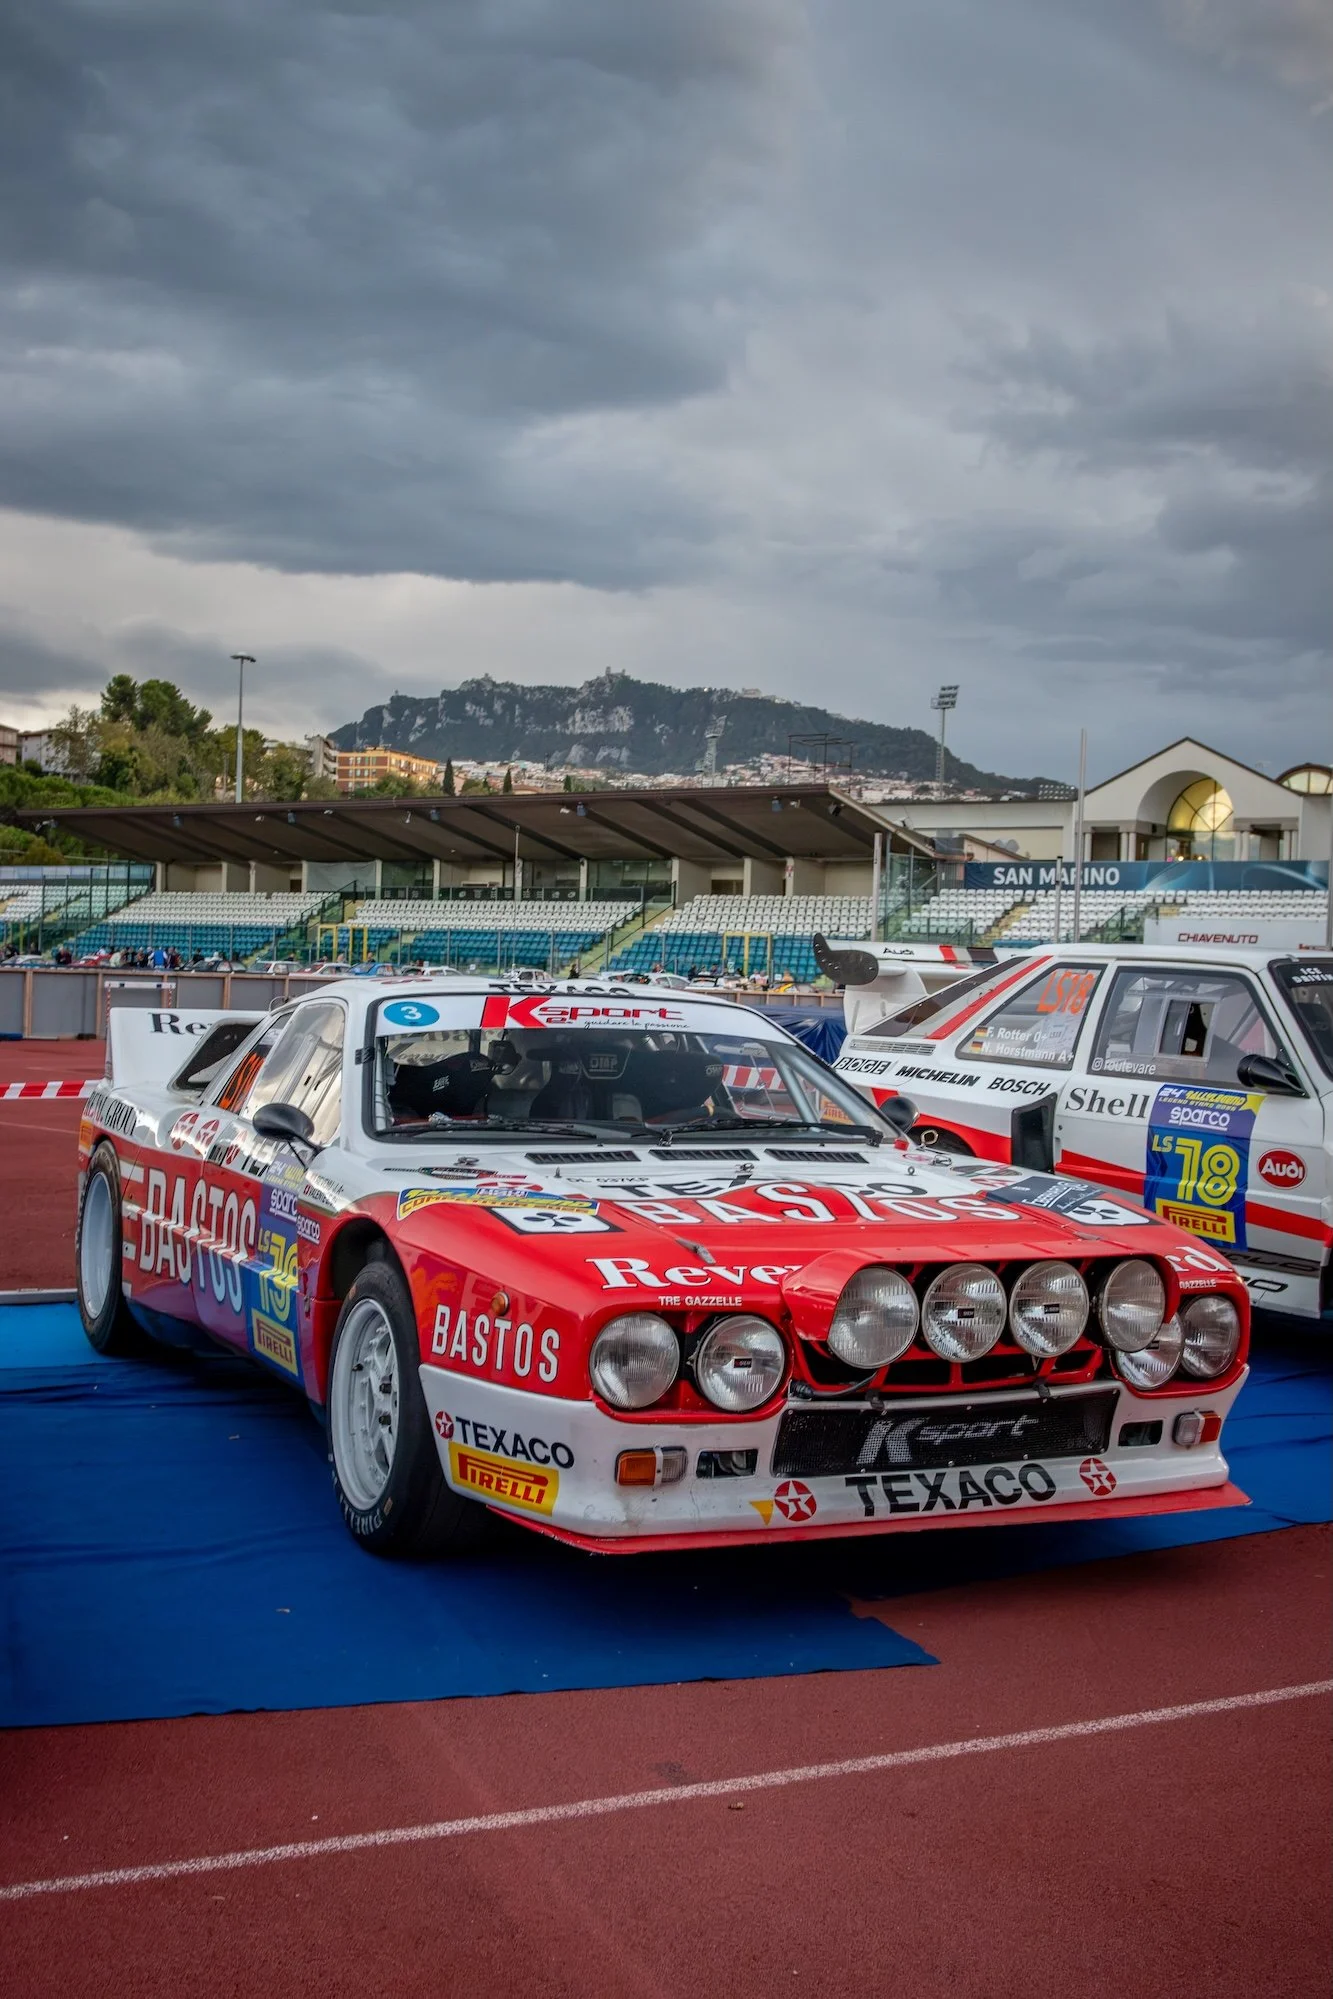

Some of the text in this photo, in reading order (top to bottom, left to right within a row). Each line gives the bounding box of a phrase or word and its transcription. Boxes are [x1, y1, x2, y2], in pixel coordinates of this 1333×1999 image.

[993, 867, 1033, 885] SAN
[1177, 932, 1259, 944] CHIAVENUTO
[1299, 967, 1323, 975] ICE
[147, 1012, 212, 1036] Re
[400, 1006, 422, 1020] 3
[997, 1027, 1033, 1041] Rotter
[996, 1043, 1055, 1060] Horstmann
[1057, 1050, 1074, 1061] A+
[833, 1057, 1051, 1096] BOGE MICHELIN BOSCH
[1064, 1087, 1150, 1119] Shell
[1168, 1106, 1231, 1128] sparco
[1152, 1134, 1173, 1152] LS
[270, 1188, 298, 1216] sparc
[610, 1181, 1022, 1224] BASTOS
[1162, 1205, 1227, 1236] PIRELLI
[140, 1167, 256, 1312] BASTOS
[586, 1257, 803, 1290] Reve
[658, 1296, 743, 1307] TRE GAZZELLE
[256, 1318, 293, 1364] PIRELLI
[431, 1303, 561, 1383] BASTOS
[455, 1416, 575, 1469] TEXACO
[457, 1452, 549, 1504] PIRELLI
[845, 1463, 1057, 1517] TEXACO
